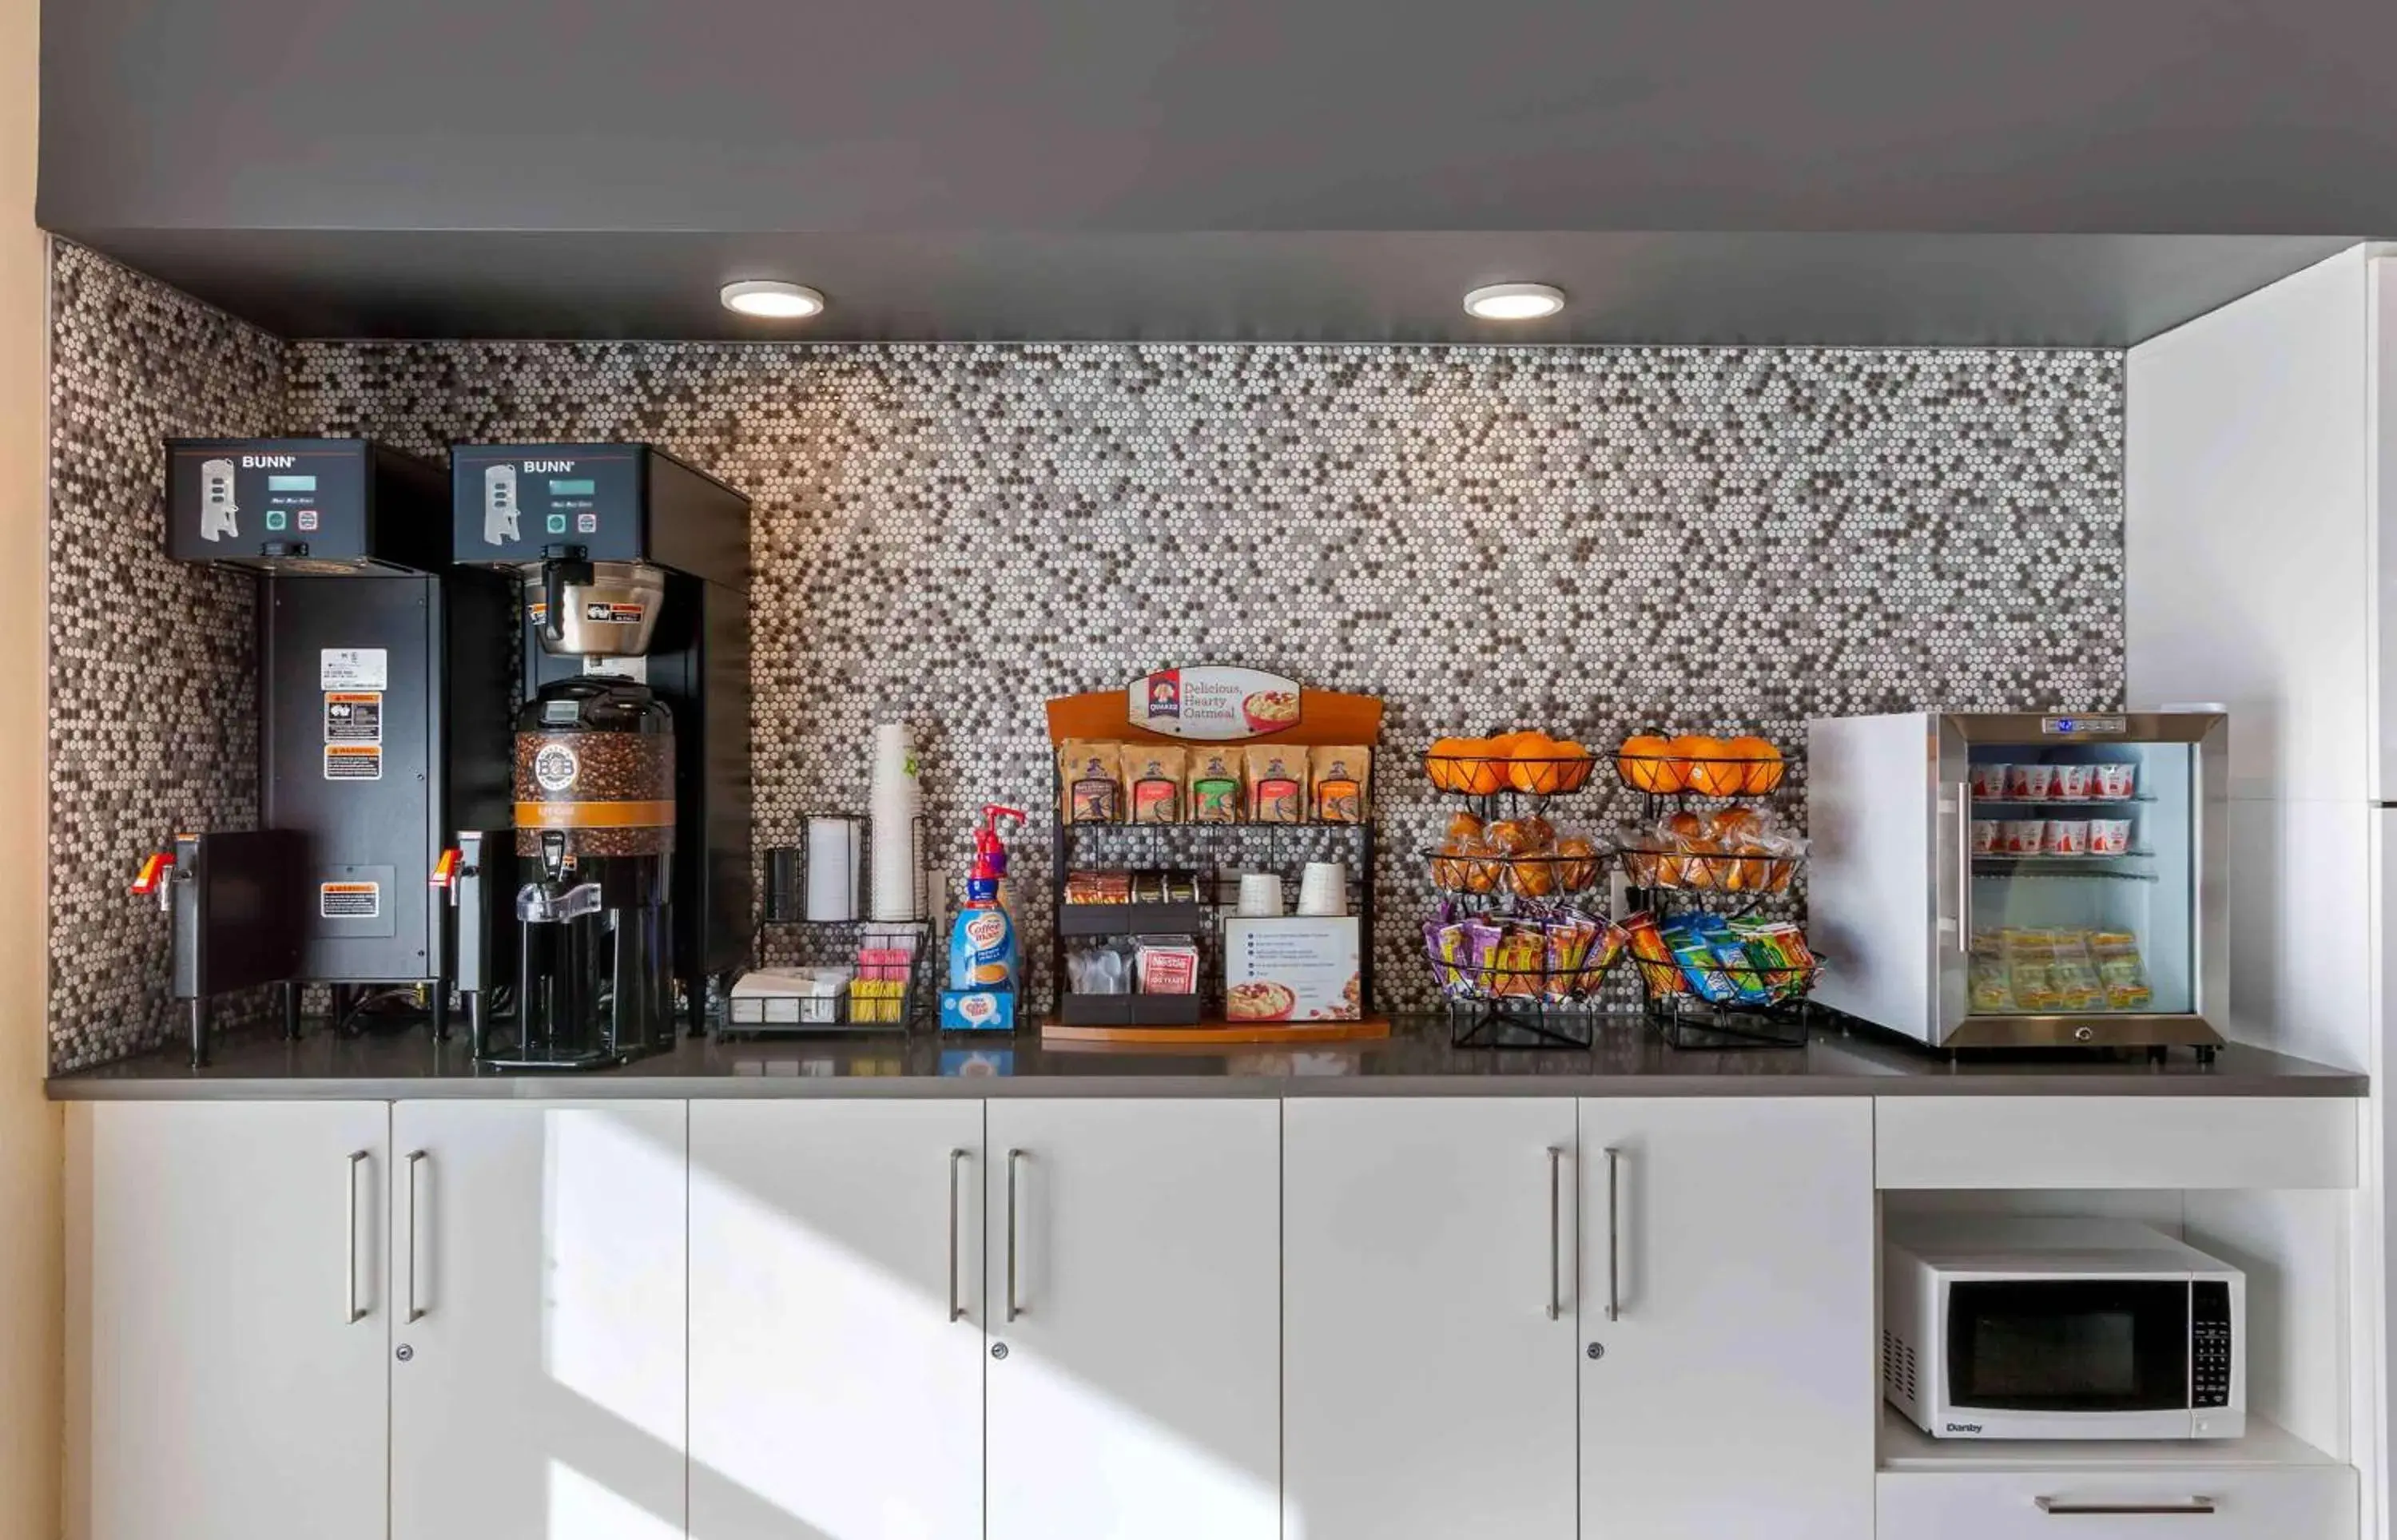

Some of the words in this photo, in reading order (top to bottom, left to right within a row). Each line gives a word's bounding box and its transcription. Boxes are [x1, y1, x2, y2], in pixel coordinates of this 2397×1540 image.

[242, 456, 292, 468] BUNN
[524, 461, 572, 473] BUNN
[1184, 681, 1243, 694] Delicious,
[1184, 694, 1227, 708] Hearty
[1184, 706, 1235, 719] Oatmeal
[1946, 1423, 1982, 1435] Danby
